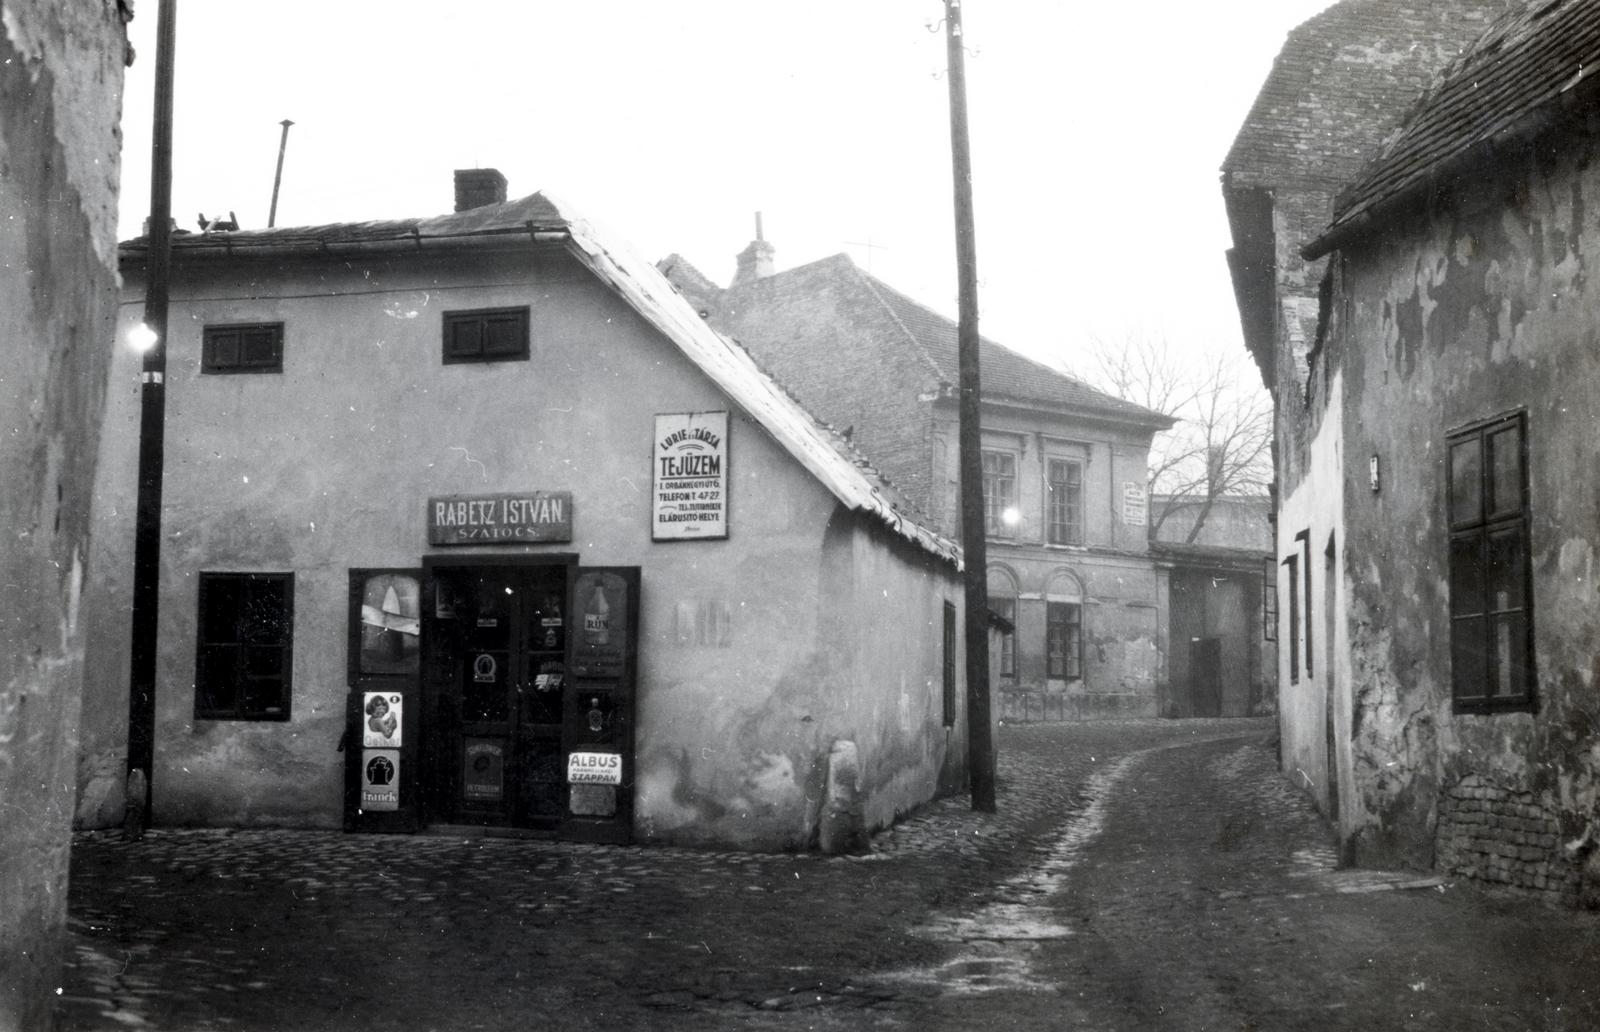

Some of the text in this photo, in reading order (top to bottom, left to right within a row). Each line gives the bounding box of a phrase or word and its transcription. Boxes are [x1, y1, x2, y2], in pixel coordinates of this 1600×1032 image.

[660, 429, 687, 451] LURIE
[694, 427, 720, 450] TÁRSA
[660, 452, 720, 476] TEJÜZEM
[659, 492, 690, 501] TELEFON
[435, 501, 496, 526] RABETZ
[698, 512, 720, 521] HELYE
[570, 755, 618, 768] ALBUS
[570, 773, 617, 782] SZAPPAN
